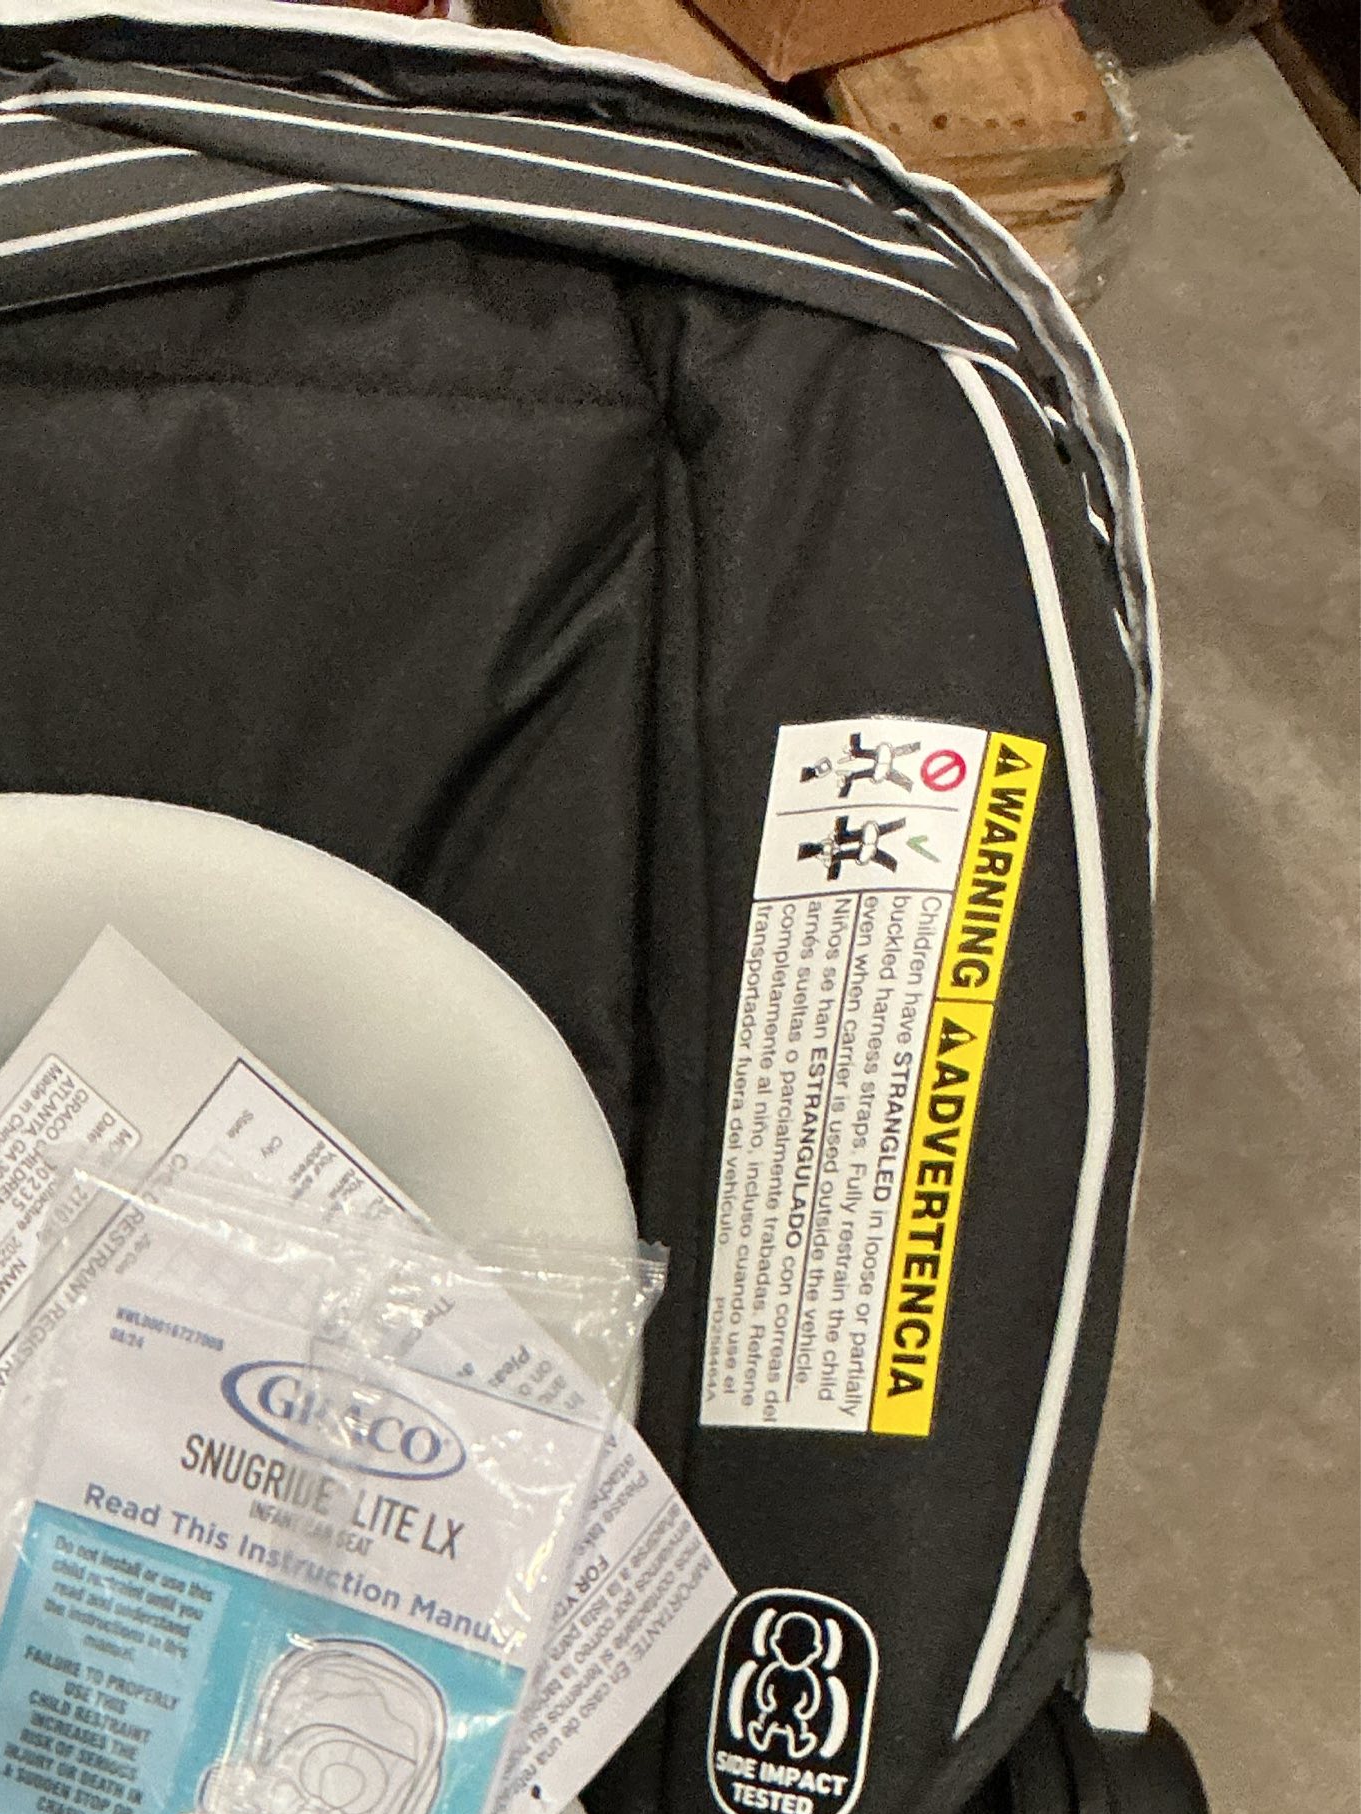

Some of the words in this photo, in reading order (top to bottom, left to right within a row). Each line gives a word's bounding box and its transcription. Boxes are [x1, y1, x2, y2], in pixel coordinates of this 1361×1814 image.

[949, 786, 1027, 988] WARNING
[855, 894, 879, 947] even
[877, 894, 912, 981] buckled
[906, 895, 943, 985] Children
[738, 904, 773, 1050] transportador
[758, 901, 797, 1071] completamente
[786, 965, 811, 1043] sueltas
[819, 966, 837, 992] se
[845, 952, 870, 1013] when
[812, 997, 836, 1040] han
[862, 986, 895, 1075] harness
[895, 991, 924, 1045] have
[26, 1061, 64, 1103] Made
[784, 1048, 799, 1064] o
[834, 1018, 858, 1089] carrier
[730, 1055, 753, 1111] fuera
[755, 1074, 774, 1095] al
[829, 1094, 850, 1113] is
[44, 1087, 90, 1141] GRACO
[224, 1108, 254, 1139] State
[726, 1116, 744, 1150] del
[764, 1069, 797, 1211] parcialmente
[871, 1050, 913, 1203] STRANGLED
[2, 1137, 27, 1162] GA
[258, 1134, 284, 1160] City
[784, 1045, 829, 1249] ESTRANGULADO
[820, 1118, 843, 1174] used
[738, 1160, 764, 1239] incluso
[838, 1162, 868, 1214] Fully
[809, 1179, 834, 1261] outside
[867, 1209, 888, 1229] in
[885, 1059, 970, 1398] ADVERTENCIA
[62, 1202, 146, 1306] RESTRAINT
[778, 1254, 796, 1296] con
[829, 1219, 855, 1302] restrain
[857, 1235, 884, 1296] loose
[728, 1242, 750, 1326] cuando
[803, 1267, 825, 1302] the
[854, 1301, 871, 1325] or
[766, 1302, 789, 1383] correas
[823, 1307, 846, 1344] the
[740, 1323, 766, 1407] Refrene
[816, 1348, 840, 1402] child
[837, 1330, 867, 1417] partially
[762, 1389, 780, 1423] del
[179, 1431, 336, 1516] SNUGRIDE
[347, 1488, 420, 1545] LITE
[419, 1511, 465, 1561] LX
[247, 1497, 296, 1530] INFAN
[334, 1526, 375, 1558] SEAT
[82, 1481, 163, 1529] Read
[170, 1509, 230, 1552] This
[236, 1533, 401, 1612] Instruction
[406, 1592, 528, 1667] Manu
[570, 1552, 610, 1595] FOR
[715, 1750, 758, 1779] SIDE
[759, 1761, 848, 1796] IMPACT
